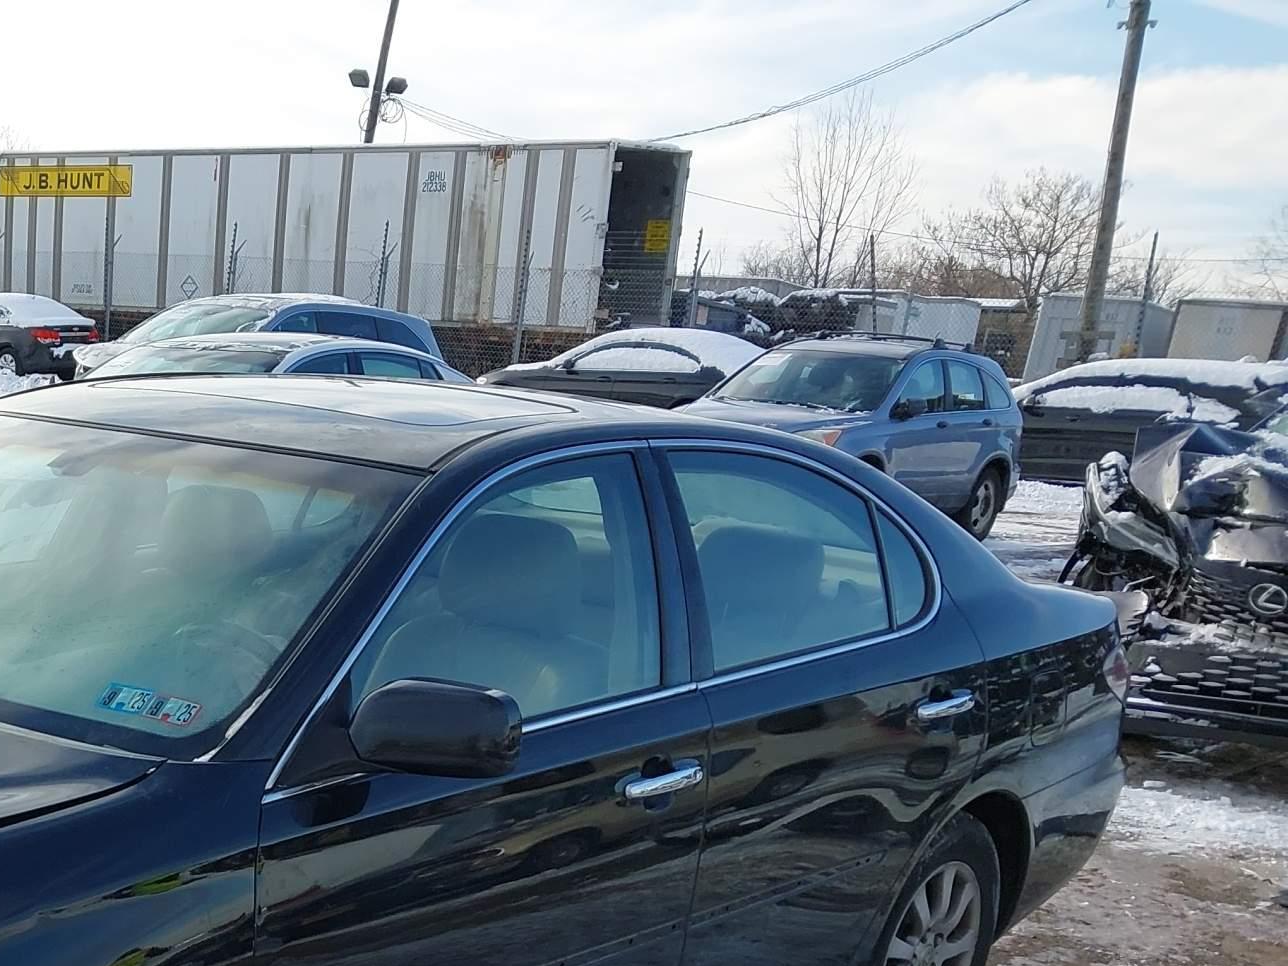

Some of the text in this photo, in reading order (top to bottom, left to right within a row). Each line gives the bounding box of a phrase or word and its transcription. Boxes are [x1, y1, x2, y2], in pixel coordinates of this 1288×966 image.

[57, 172, 105, 190] HUNT
[425, 170, 446, 182] JBHU
[421, 181, 447, 193] 212338
[131, 692, 151, 710] 25
[176, 703, 197, 723] 25
